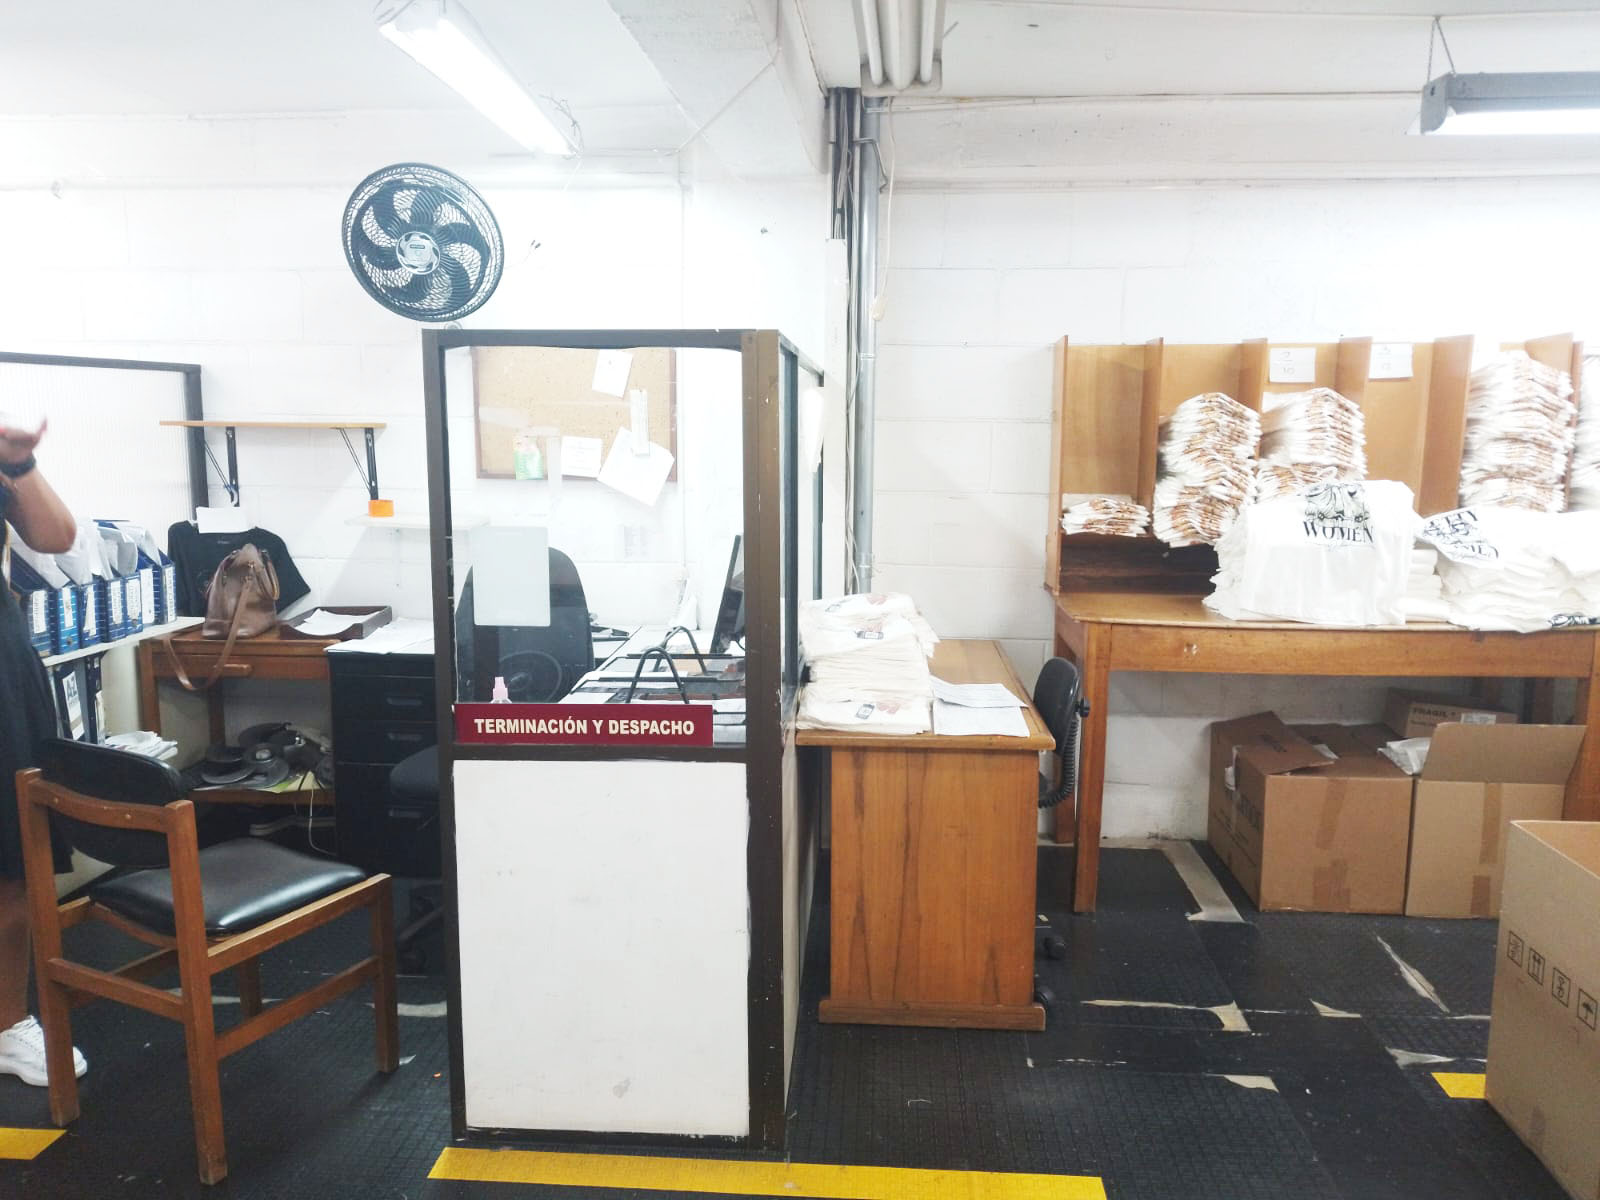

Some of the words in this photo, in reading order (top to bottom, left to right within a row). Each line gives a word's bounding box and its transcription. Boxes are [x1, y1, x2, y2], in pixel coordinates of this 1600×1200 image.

[1303, 520, 1374, 544] WOMEN
[473, 716, 588, 735] TERMINACIÓN
[592, 719, 603, 734] Y
[608, 719, 695, 735] DESPACHO
